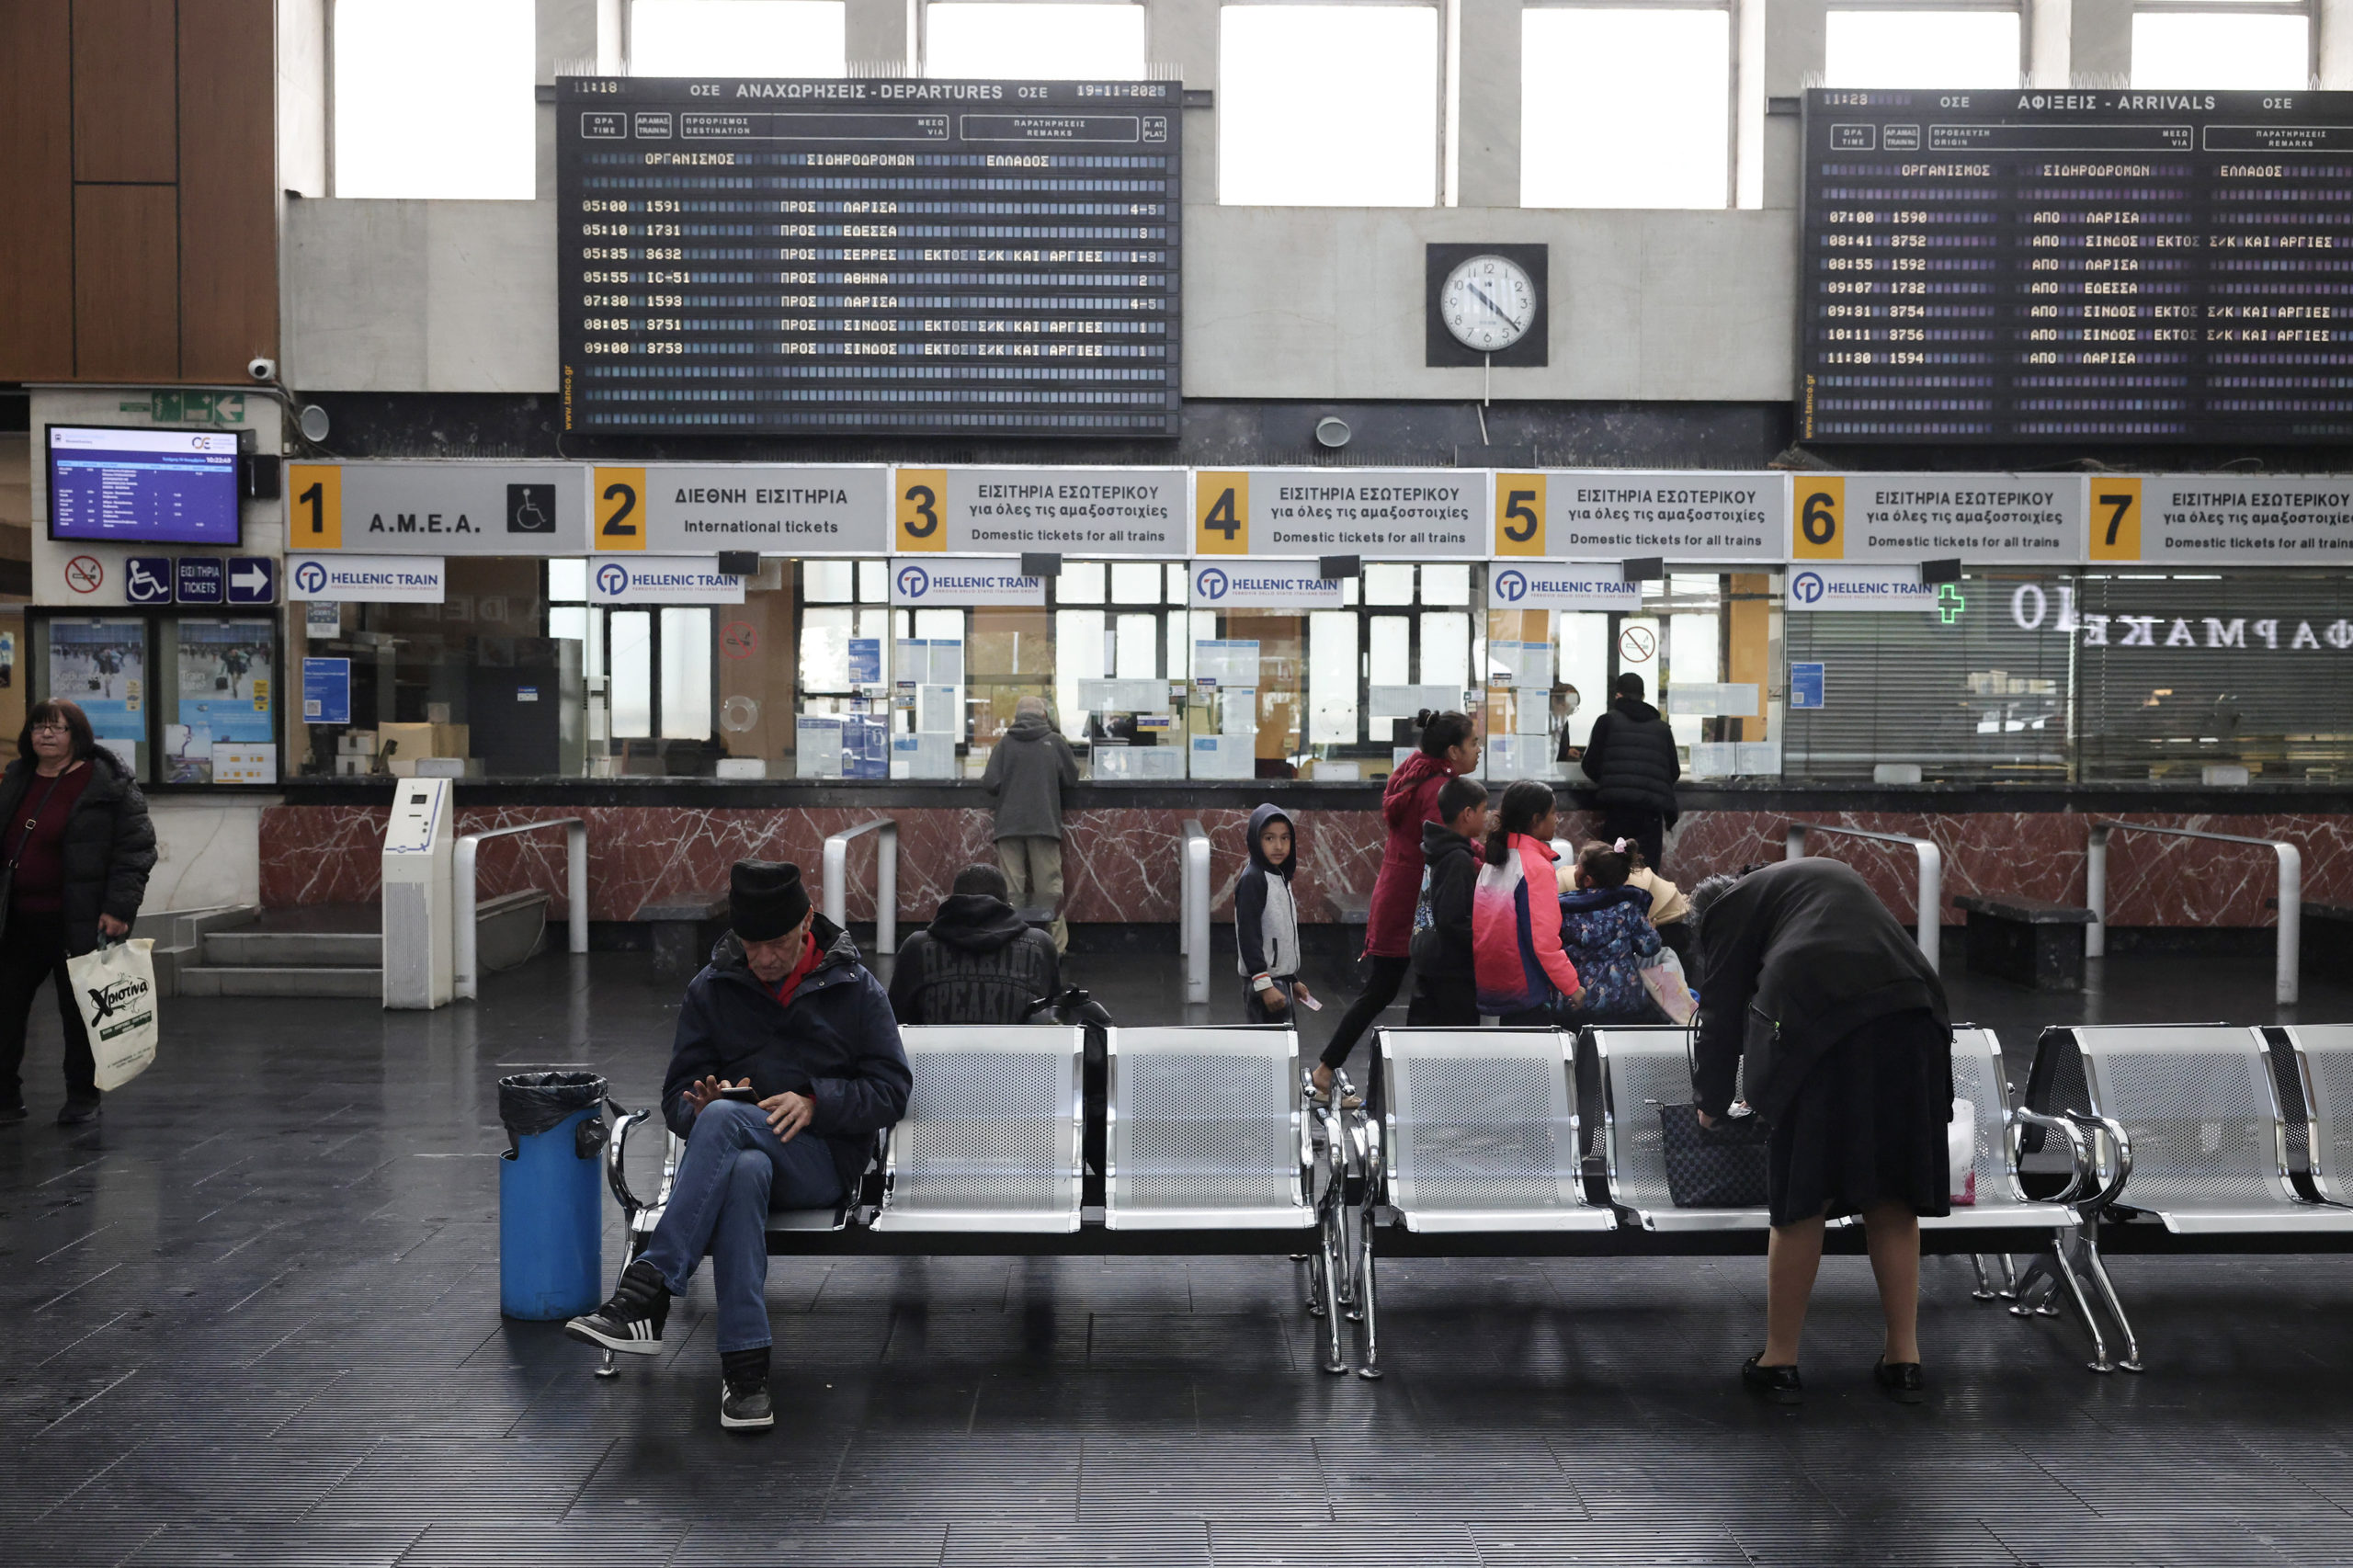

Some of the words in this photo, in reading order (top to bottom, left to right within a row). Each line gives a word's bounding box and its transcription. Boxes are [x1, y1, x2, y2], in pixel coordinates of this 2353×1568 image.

[690, 85, 721, 97] ΟΣΕ
[736, 84, 866, 98] ΑΝΑΧΩΡΗΣΕΙΣ
[881, 85, 1003, 99] DEPARTURES
[1017, 86, 1048, 98] ΟΣΕ
[1940, 97, 1970, 108] ΟΣΕ
[2018, 96, 2097, 109] ΑΦΙΞΕΙΣ
[2118, 96, 2216, 109] ARRIVALS
[2263, 97, 2292, 108] ΟΣΕ
[645, 153, 735, 165] ΟΡΓΑΝΙΣΜΟΣ
[807, 154, 915, 166] ΣΙΔΗΡΟΔΡΟΜΩΝ
[987, 155, 1049, 167] ΕΛΛΑΔΟΣ
[1902, 165, 1990, 176] ΟΡΓΑΝΙΣΜΟΣ
[2043, 165, 2150, 176] ΣΙΔΗΡΟΔΡΟΜΩΝ
[2221, 165, 2282, 176] ΕΛΛΑΔΟΣ
[583, 200, 628, 212] 05:00
[646, 201, 680, 212] 1591
[780, 201, 816, 212] ΠΡΟΣ
[843, 201, 897, 213] ΛΑΡΙΣΑ
[1829, 211, 1874, 222] 07:00
[1893, 211, 1927, 222] 1590
[2033, 212, 2060, 223] ΑΠΟ
[2086, 212, 2140, 223] ΛΑΡΙΣΑ
[583, 224, 628, 236] 05:10
[646, 224, 680, 236] 1731
[780, 224, 816, 236] ΠΡΟΣ
[843, 225, 897, 237] ΕΔΕΣΣΑ
[1829, 235, 1872, 246] 08:41
[1892, 235, 1927, 246] 3752
[2032, 235, 2059, 246] ΑΠΟ
[2086, 235, 2139, 247] ΣΙΝΔΟΣ
[2245, 236, 2270, 247] ΚΑΙ
[2279, 236, 2333, 247] ΑΡΓΙΕΣ
[583, 248, 628, 260] 05:35
[646, 248, 681, 260] 3632
[780, 248, 816, 260] ΠΡΟΣ
[843, 249, 897, 261] ΣΕΡΡΕΣ
[1014, 251, 1040, 262] ΚΑΙ
[1050, 251, 1103, 263] ΑΡΓΙΕΣ
[1828, 259, 1873, 270] 08:55
[1892, 259, 1926, 270] 1592
[2032, 259, 2059, 270] ΑΠΟ
[2086, 259, 2139, 270] ΛΑΡΙΣΑ
[584, 272, 629, 283] 05:55
[781, 272, 816, 283] ΠΡΟΣ
[844, 272, 889, 284] ΑΘΗΝΑ
[675, 488, 746, 504] ΔΙΕΘΝΗ
[756, 489, 847, 505] ΕΙΣΙΤΗΡΙΑ
[979, 485, 1054, 499] ΕΙΣΙΤΗΡΙΑ
[1059, 486, 1159, 499] ΕΣΩΤΕΡΙΚΟΥ
[1280, 487, 1356, 501] ΕΙΣΙΤΗΡΙΑ
[1360, 488, 1460, 501] ΕΣΩΤΕΡΙΚΟΥ
[1577, 489, 1652, 503] ΕΙΣΙΤΗΡΙΑ
[1657, 490, 1756, 504] ΕΣΩΤΕΡΙΚΟΥ
[1876, 492, 1950, 505] ΕΙΣΙΤΗΡΙΑ
[1955, 493, 2054, 506] ΕΣΩΤΕΡΙΚΟΥ
[2173, 494, 2246, 506] ΕΙΣΙΤΗΡΙΑ
[2252, 494, 2350, 507] ΕΣΩΤΕΡΙΚΟΥ
[300, 483, 323, 533] 1
[603, 483, 636, 535] 2
[904, 485, 938, 538] 3
[970, 506, 992, 517] για
[996, 504, 1030, 517] όλες
[1036, 506, 1056, 517] τις
[1060, 505, 1168, 517] αμαξοστοιχίες
[1204, 488, 1241, 540] 4
[1271, 507, 1293, 519] για
[1298, 506, 1332, 518] όλες
[1336, 507, 1357, 519] τις
[1361, 506, 1469, 518] αμαξοστοιχίες
[1504, 490, 1538, 541] 5
[1568, 509, 1591, 521] για
[1595, 508, 1630, 520] όλες
[1634, 509, 1654, 521] τις
[1658, 509, 1766, 522] αμαξοστοιχίες
[1802, 493, 1836, 544] 6
[1867, 511, 1889, 523] για
[1893, 511, 1927, 523] όλες
[1932, 511, 1951, 523] τις
[1955, 511, 2063, 523] αμαξοστοιχίες
[2099, 494, 2132, 545] 7
[2164, 512, 2186, 524] για
[2190, 512, 2224, 524] όλες
[2229, 512, 2248, 524] τις
[2252, 512, 2353, 524] αμαξοστοιχίε
[369, 514, 481, 533] Α.Μ.Ε.Α.
[685, 520, 781, 533] International
[785, 521, 838, 533] tickets
[972, 529, 1033, 540] Domestic
[1038, 529, 1083, 541] tickets
[1087, 530, 1105, 540] for
[1109, 530, 1123, 540] all
[1128, 530, 1165, 541] trains
[1273, 532, 1335, 542] Domestic
[1339, 532, 1384, 543] tickets
[1388, 532, 1406, 543] for
[1410, 532, 1424, 543] all
[1429, 533, 1466, 543] trains
[1570, 534, 1631, 544] Domestic
[1636, 534, 1680, 545] tickets
[1685, 535, 1703, 545] for
[1707, 535, 1721, 545] all
[1725, 535, 1762, 546] trains
[1869, 537, 1929, 547] Domestic
[1934, 537, 1978, 547] tickets
[1983, 537, 2001, 547] for
[2004, 537, 2018, 547] all
[2022, 538, 2060, 548] trains
[2165, 538, 2226, 548] Domestic
[2230, 538, 2275, 549] tickets
[2279, 538, 2297, 549] for
[2301, 539, 2314, 549] all
[332, 573, 393, 585] HELLENIC
[398, 574, 438, 585] TRAIN
[632, 574, 694, 585] HELLENIC
[698, 574, 738, 586] TRAIN
[933, 576, 995, 587] HELLENIC
[997, 577, 1039, 588] TRAIN
[1233, 578, 1294, 590] HELLENIC
[1297, 579, 1337, 590] TRAIN
[184, 582, 217, 594] TICKETS
[1531, 581, 1592, 593] HELLENIC
[1596, 582, 1636, 593] TRAIN
[1828, 583, 1889, 594] HELLENIC
[1893, 584, 1932, 594] TRAIN
[88, 981, 149, 1028] Χριστίνα
[924, 982, 1038, 1023] SPEAKIN
